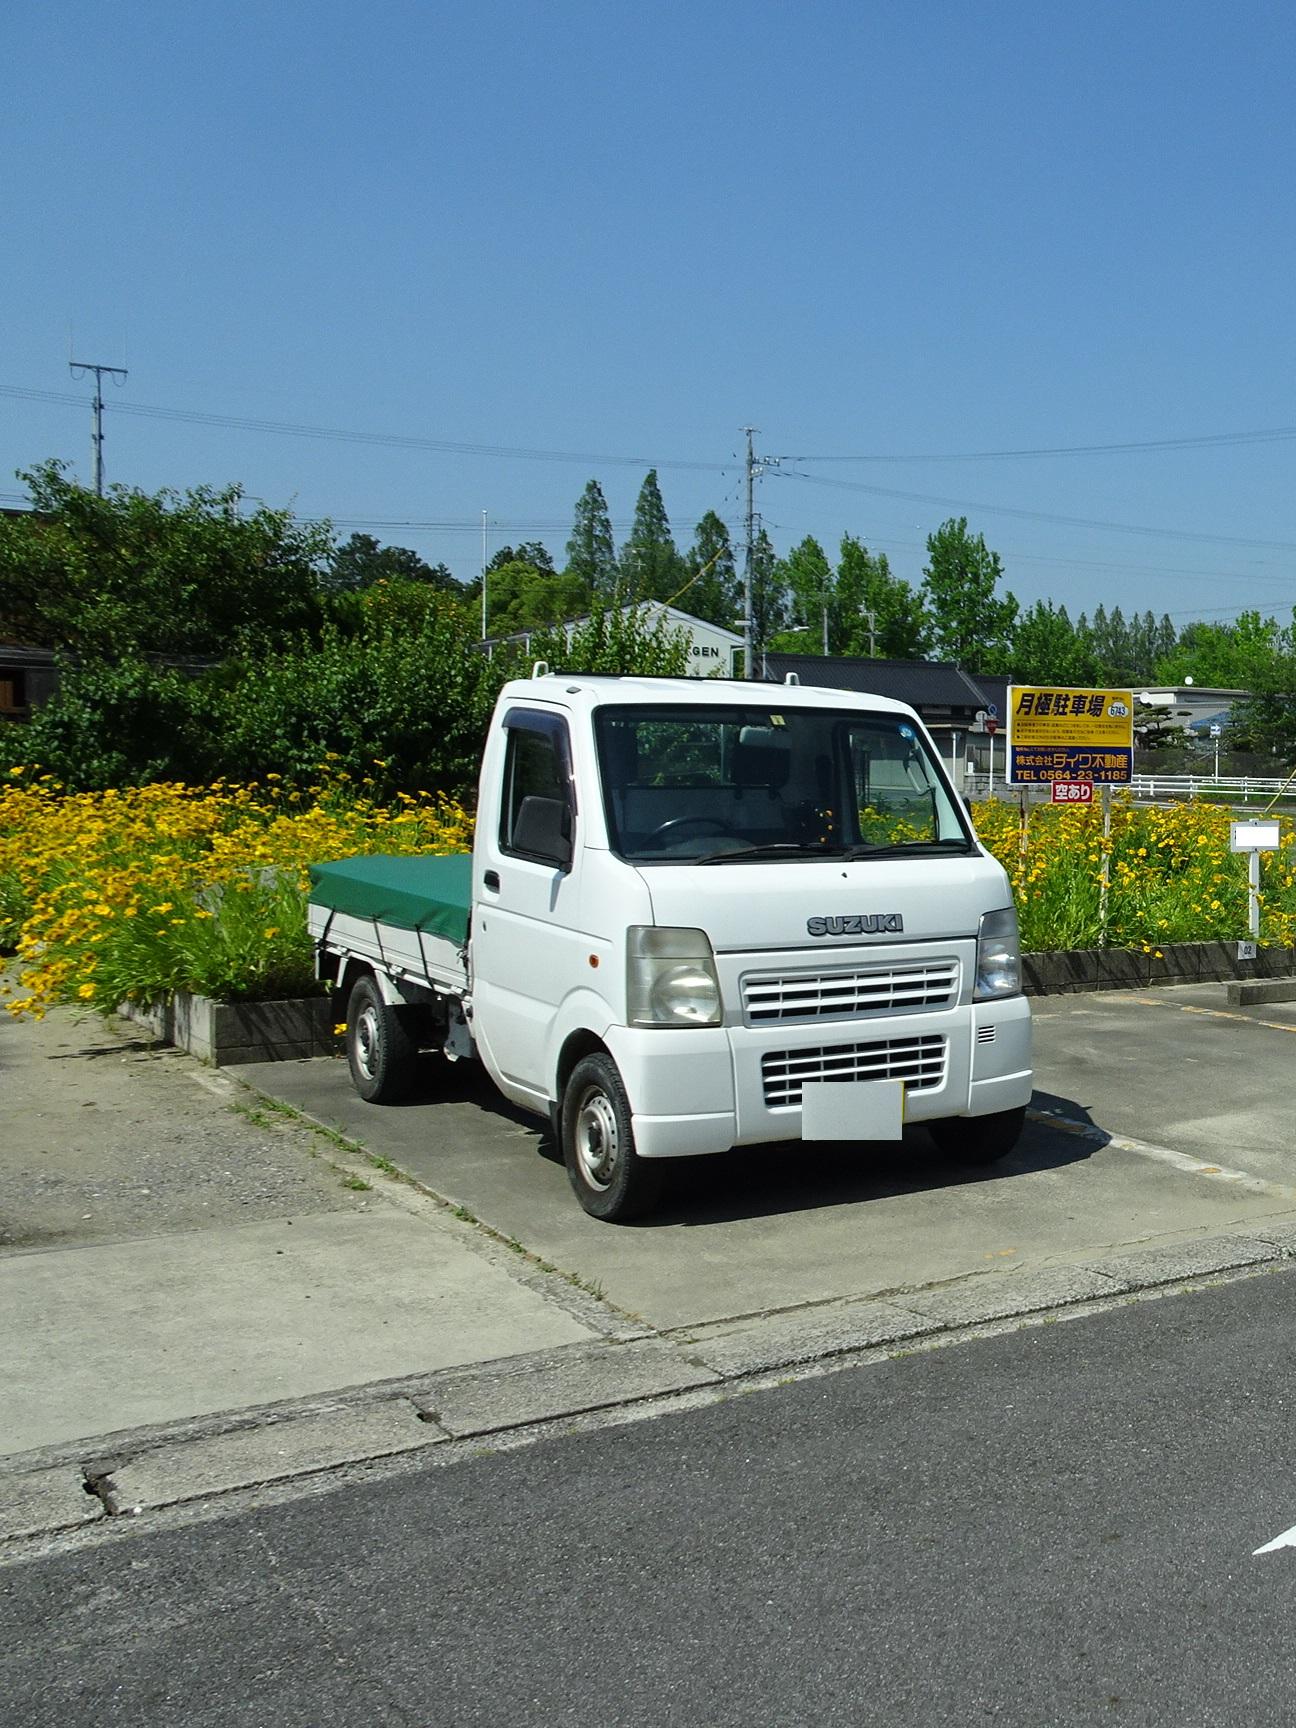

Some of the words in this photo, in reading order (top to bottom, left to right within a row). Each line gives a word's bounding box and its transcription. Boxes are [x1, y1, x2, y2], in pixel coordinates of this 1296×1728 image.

[1016, 692, 1105, 717] 月極駐車場
[1110, 705, 1126, 716] 6743
[1016, 753, 1128, 768] 株式会社ダイワ不動産
[1016, 770, 1037, 780] TEL
[1040, 770, 1127, 780] 0564-23-1185
[1055, 784, 1090, 800] 空あり
[807, 914, 904, 936] SUZUKI
[1244, 945, 1252, 955] 02
